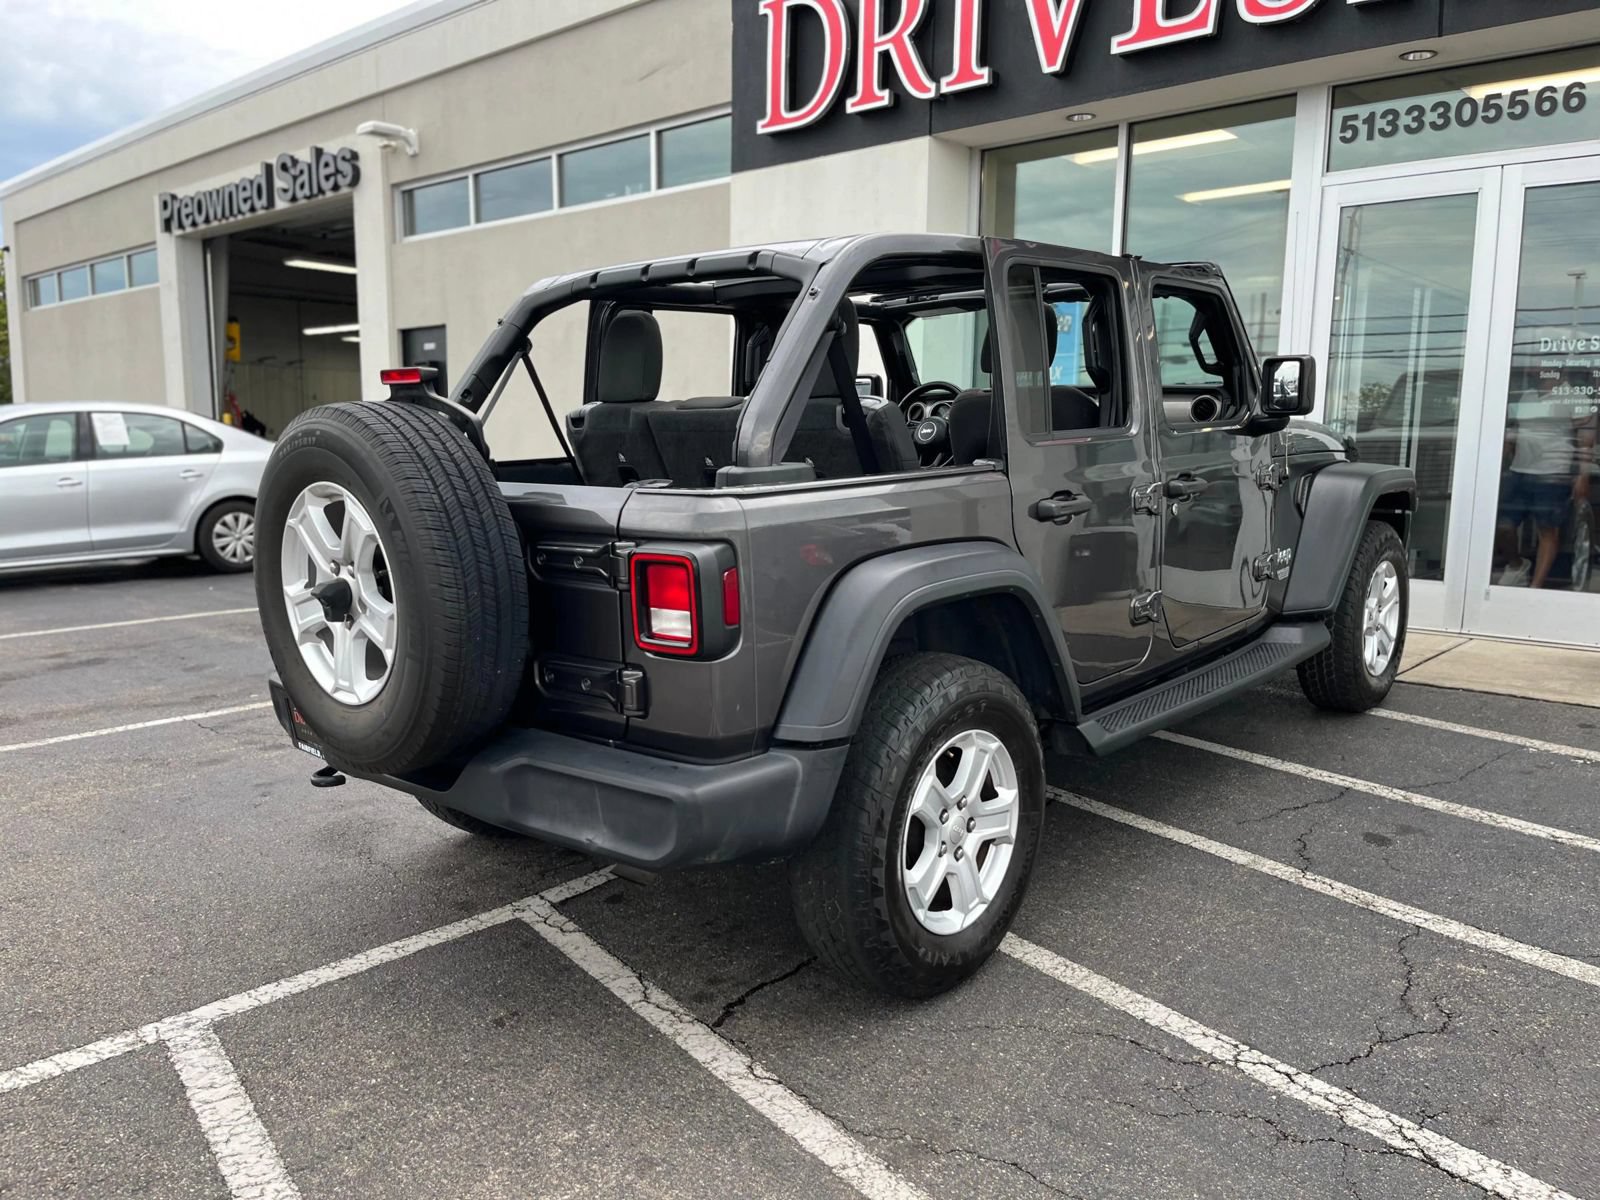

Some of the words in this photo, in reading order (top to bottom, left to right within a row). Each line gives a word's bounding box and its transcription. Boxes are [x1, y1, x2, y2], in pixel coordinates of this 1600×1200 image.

[1339, 81, 1587, 144] 5133305566
[159, 161, 274, 233] Preowned
[276, 146, 360, 202] Sales
[1540, 336, 1586, 352] Drive
